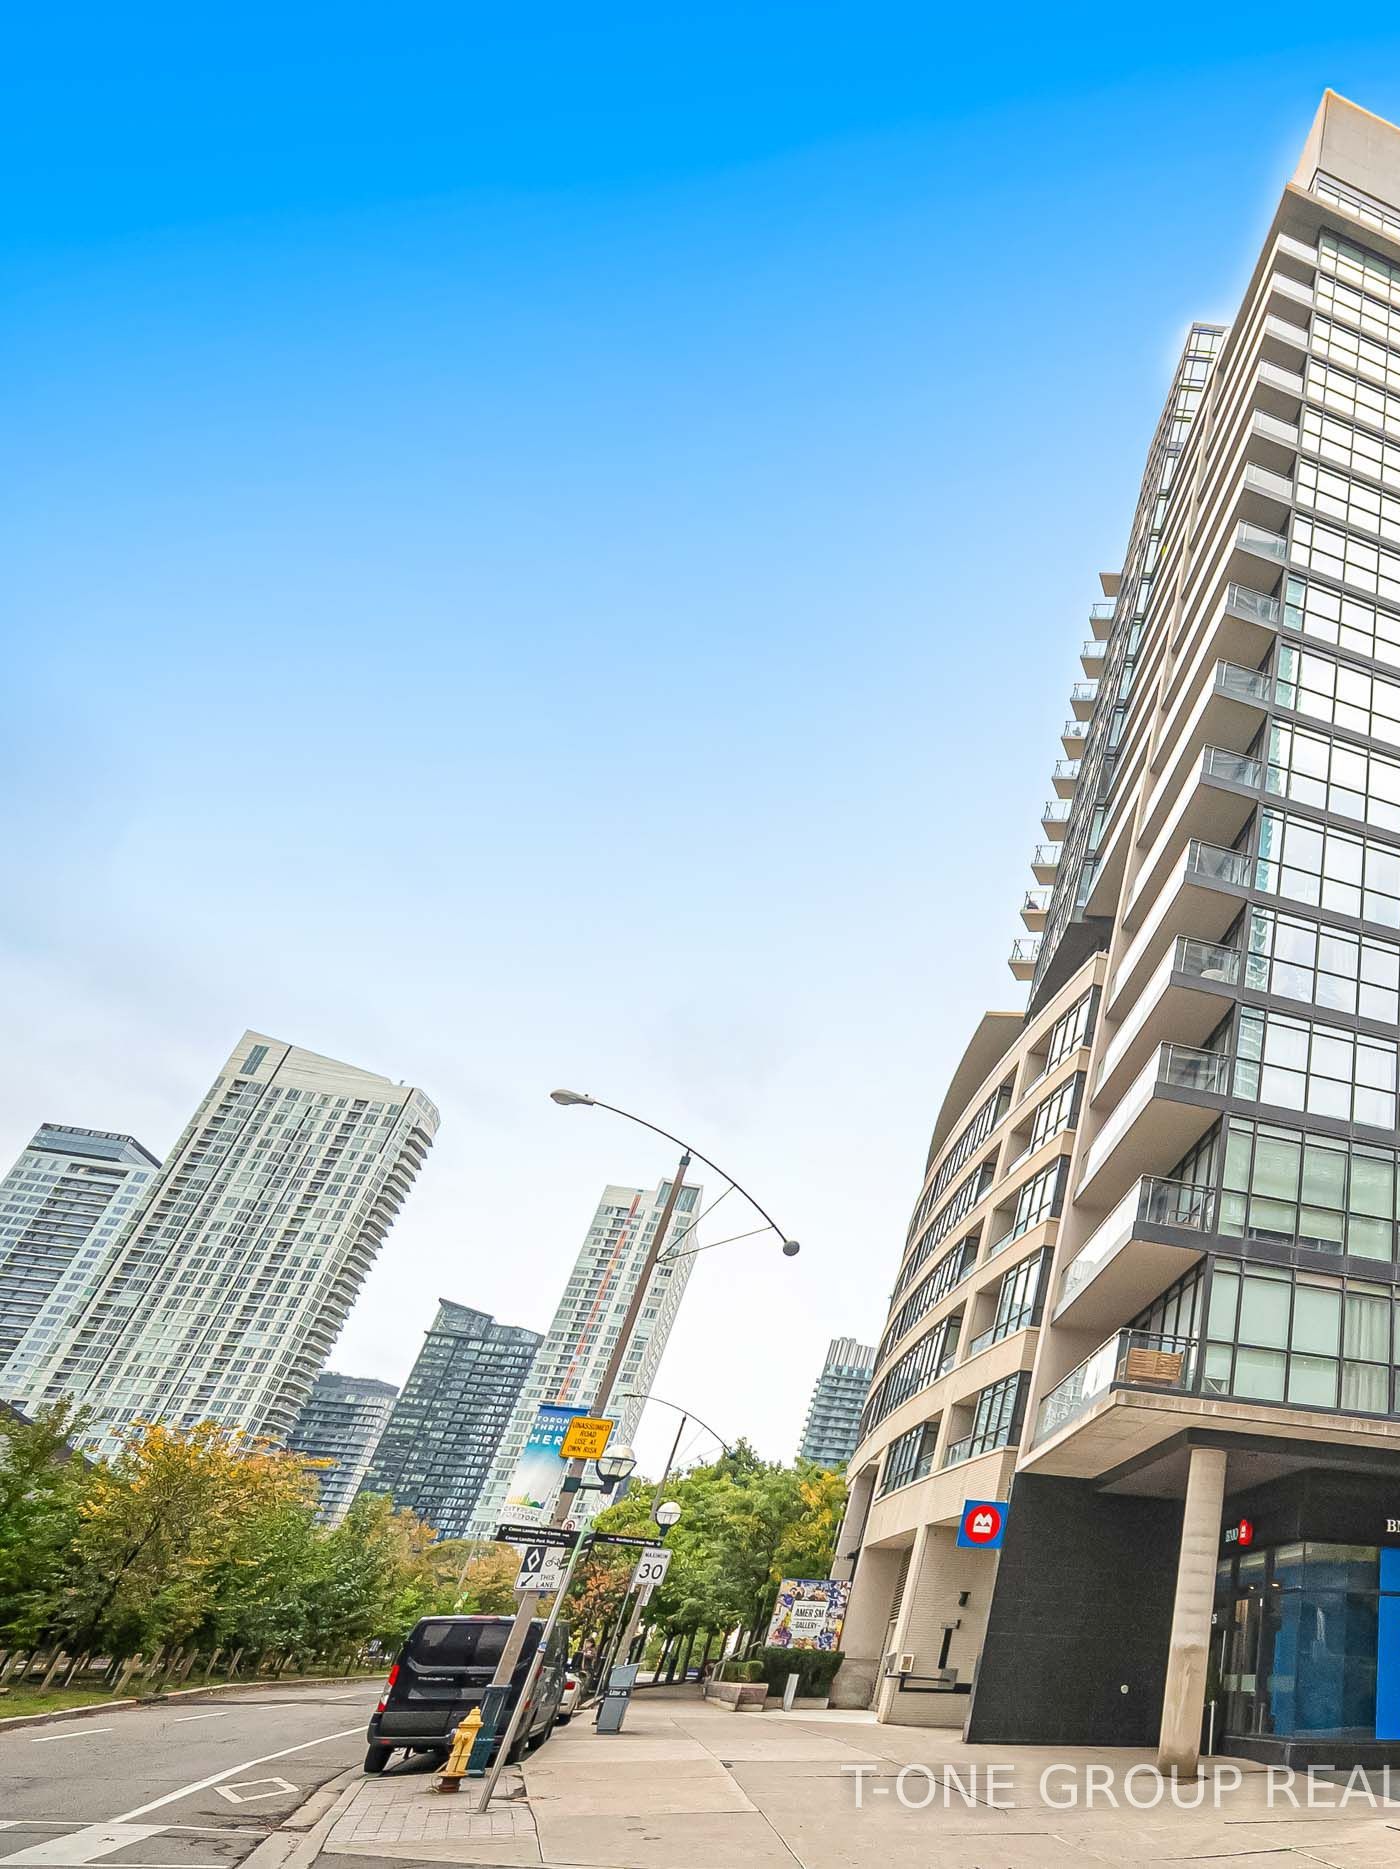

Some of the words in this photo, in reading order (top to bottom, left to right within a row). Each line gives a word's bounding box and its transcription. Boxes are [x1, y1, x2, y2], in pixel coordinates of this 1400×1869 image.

[537, 1415, 570, 1425] TORON
[533, 1423, 567, 1432] THRIV
[573, 1422, 610, 1432] UNASSUMED
[580, 1430, 597, 1438] ROAD
[529, 1433, 564, 1446] HER
[567, 1445, 580, 1453] OWN
[583, 1446, 598, 1454] RISK
[639, 1563, 663, 1580] 30
[794, 1608, 813, 1617] AMER
[794, 1621, 817, 1629] GALLERY
